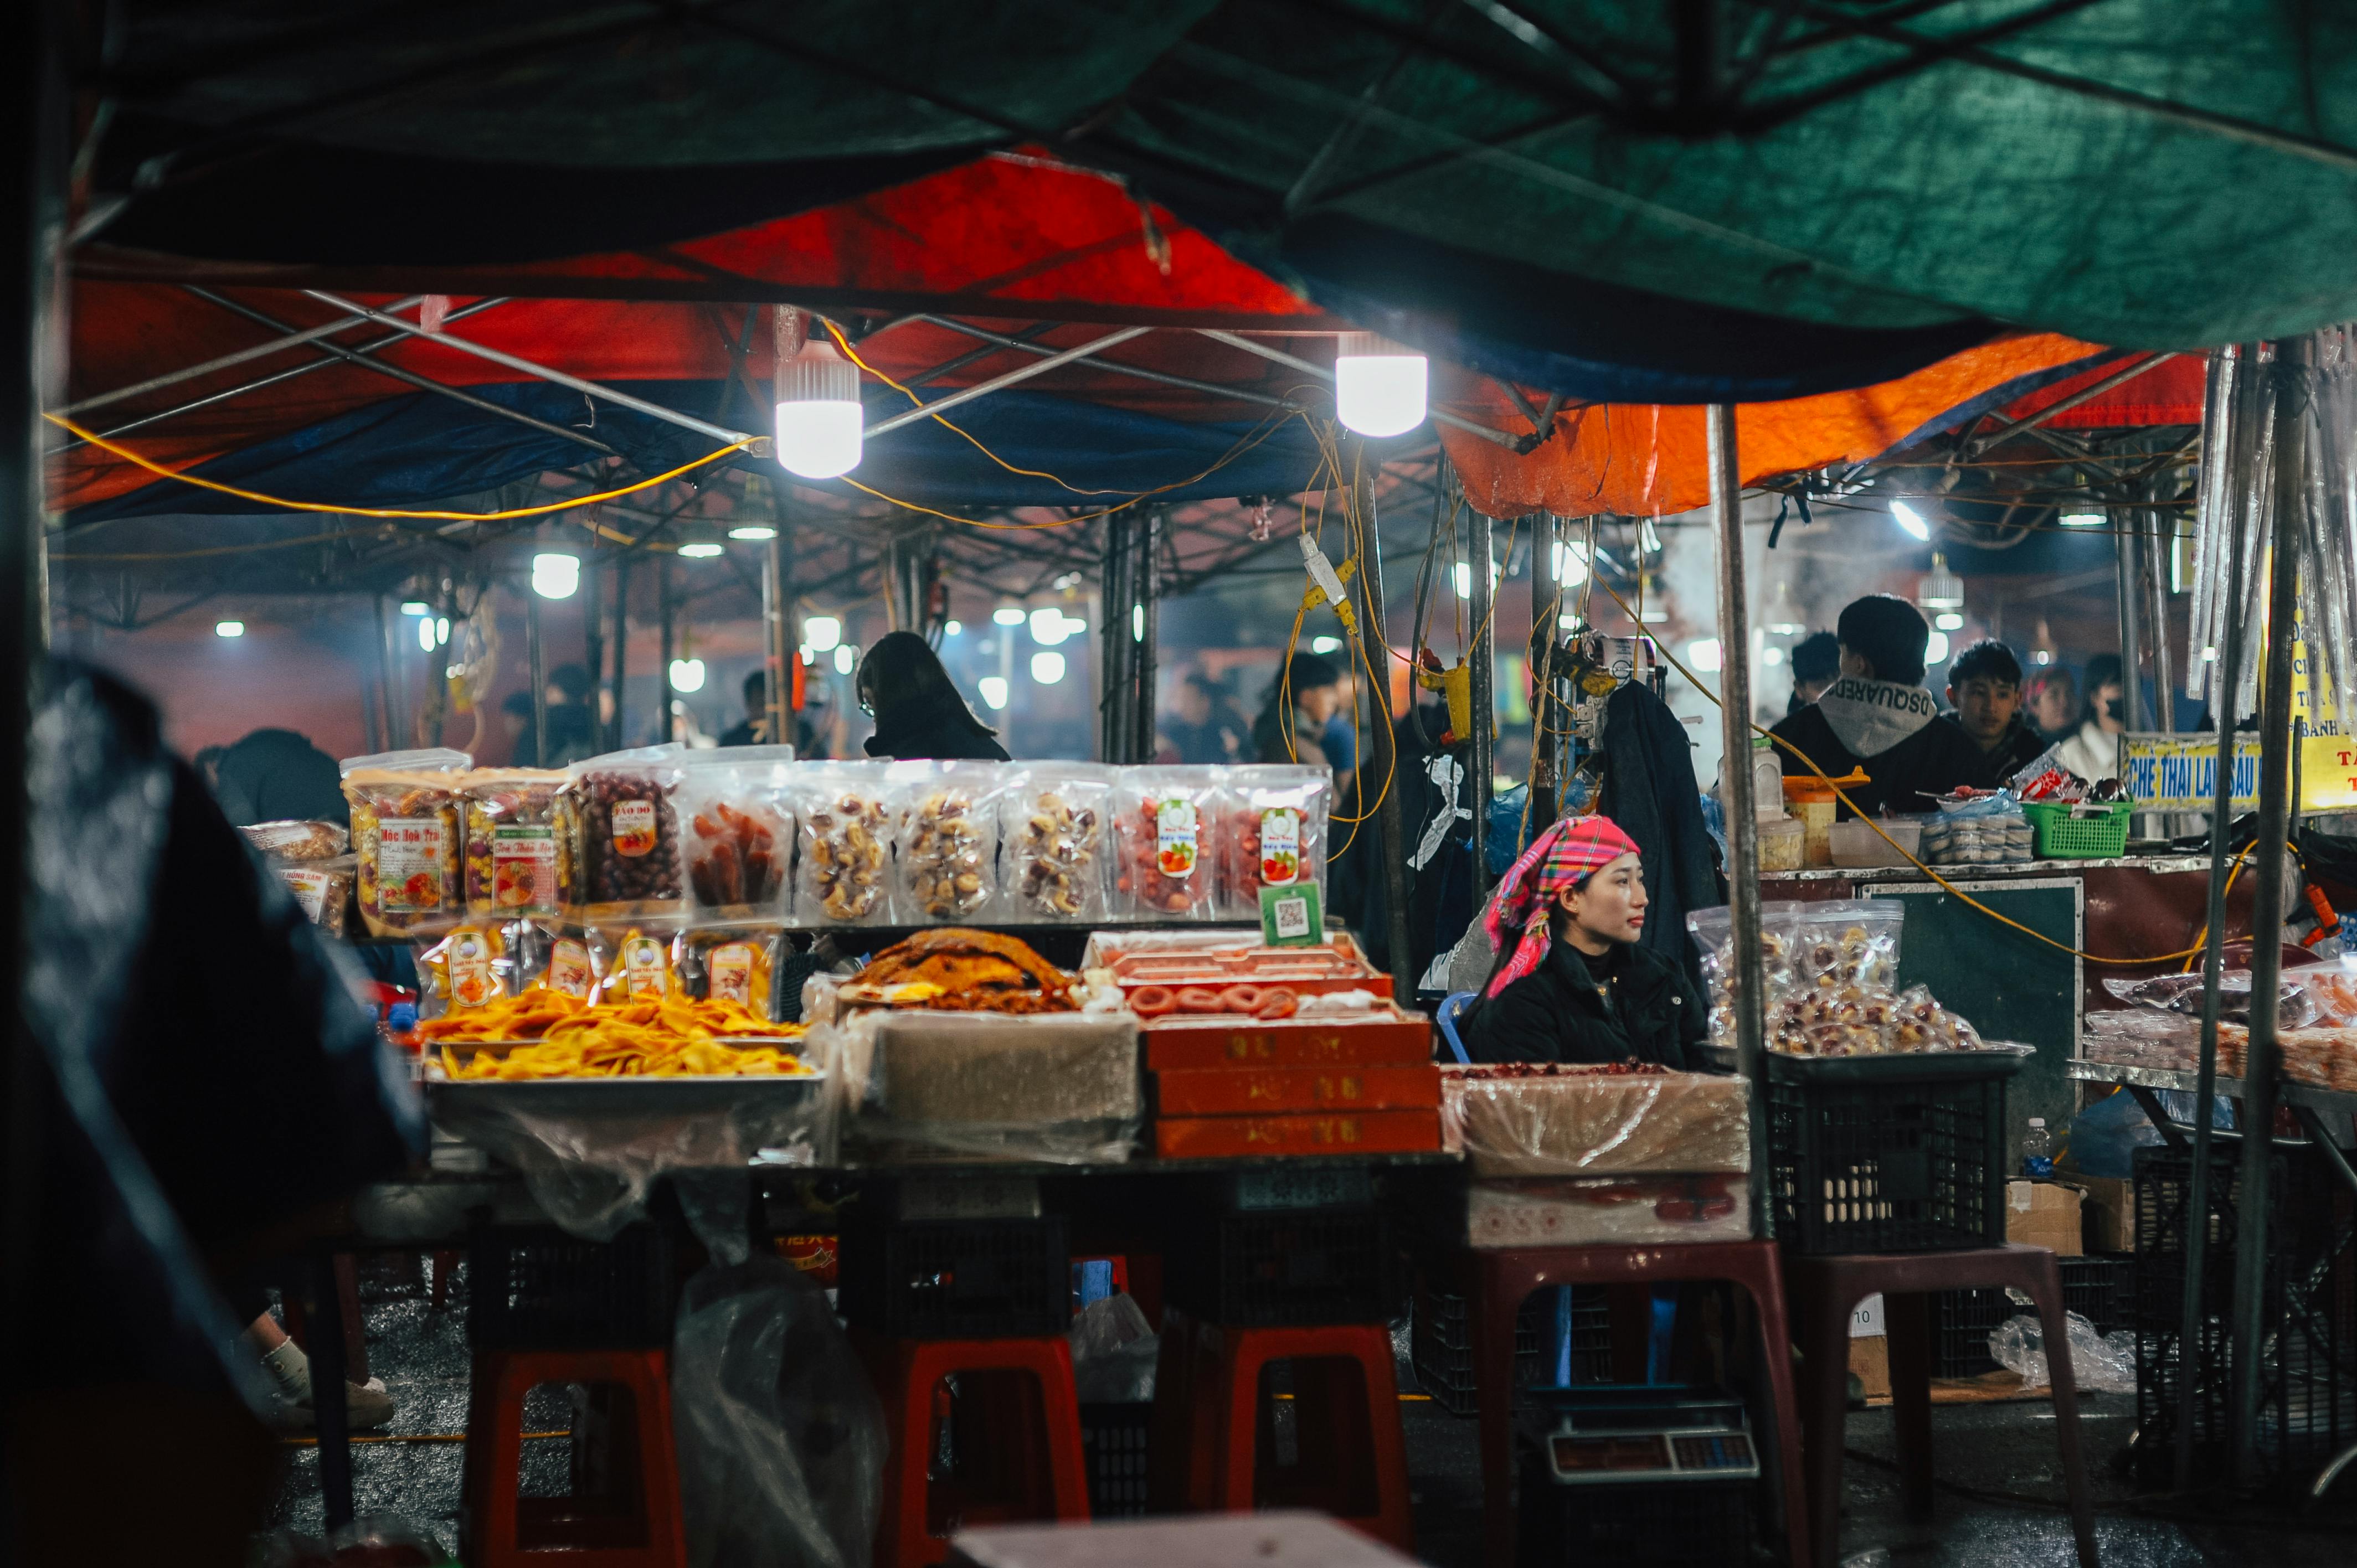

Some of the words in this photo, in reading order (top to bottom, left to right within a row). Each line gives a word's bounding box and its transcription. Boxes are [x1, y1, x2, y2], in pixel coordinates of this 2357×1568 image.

[2129, 747, 2156, 798] CHÈ
[2162, 747, 2192, 798] THÁI
[1855, 1311, 1870, 1324] 10
